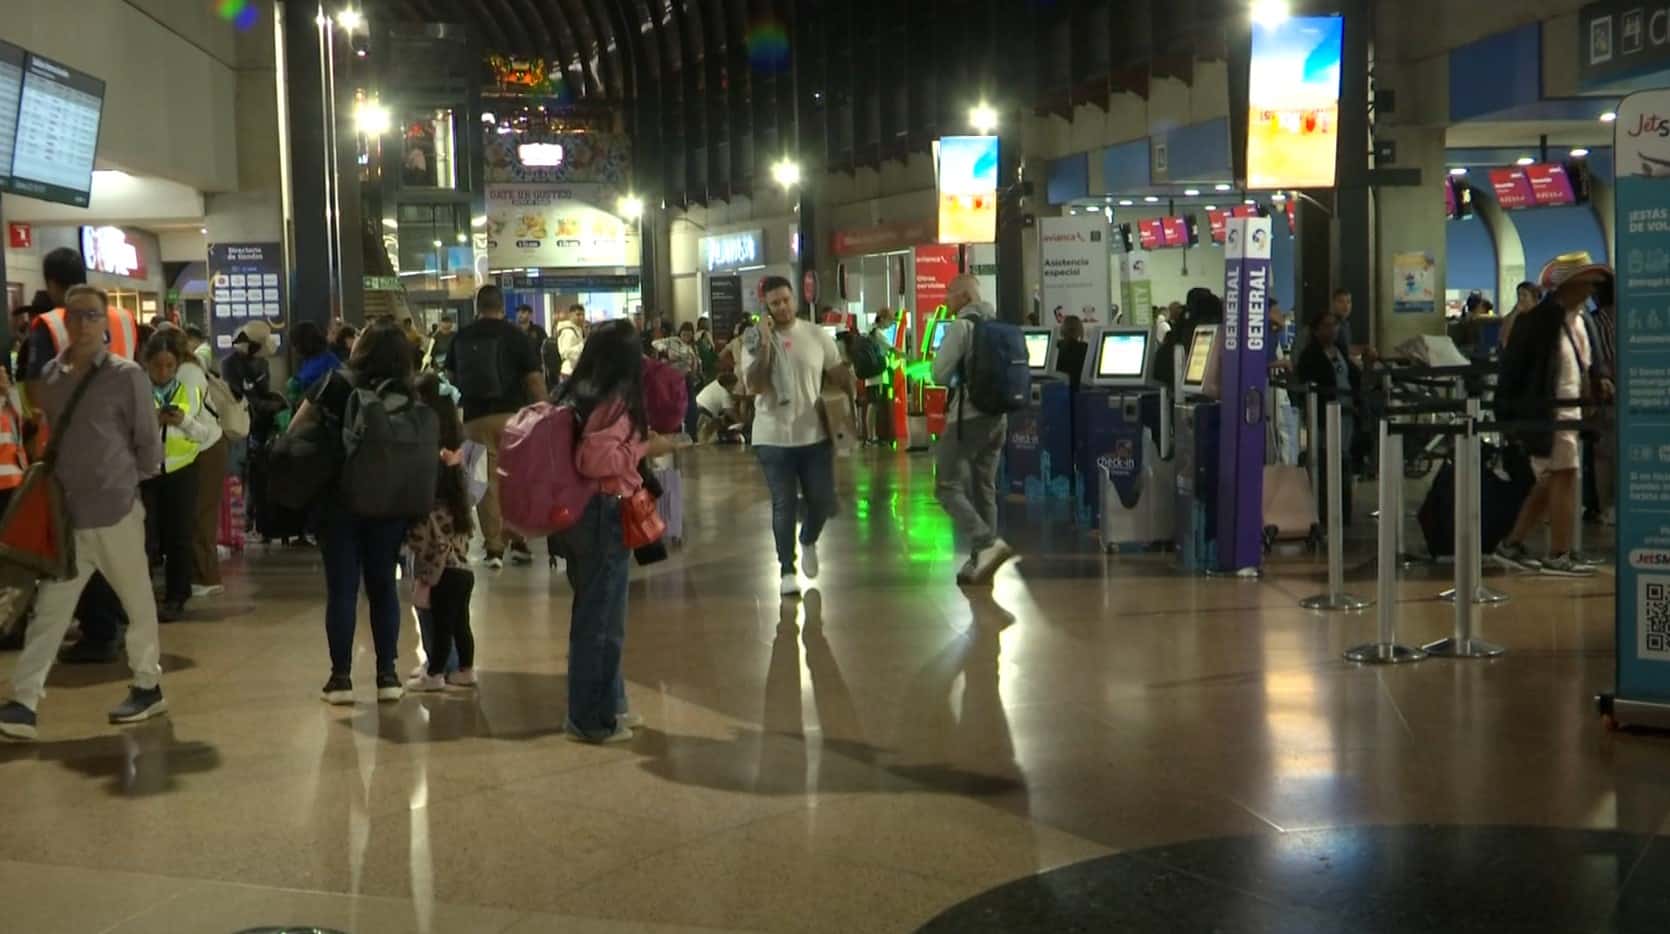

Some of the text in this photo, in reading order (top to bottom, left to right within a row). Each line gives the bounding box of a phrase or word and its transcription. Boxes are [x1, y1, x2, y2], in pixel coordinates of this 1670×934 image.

[1044, 259, 1090, 267] Asistencia
[1044, 268, 1081, 278] especial
[1224, 266, 1240, 351] GENERAL
[1247, 266, 1266, 351] GENERAL
[1096, 455, 1136, 470] check-in
